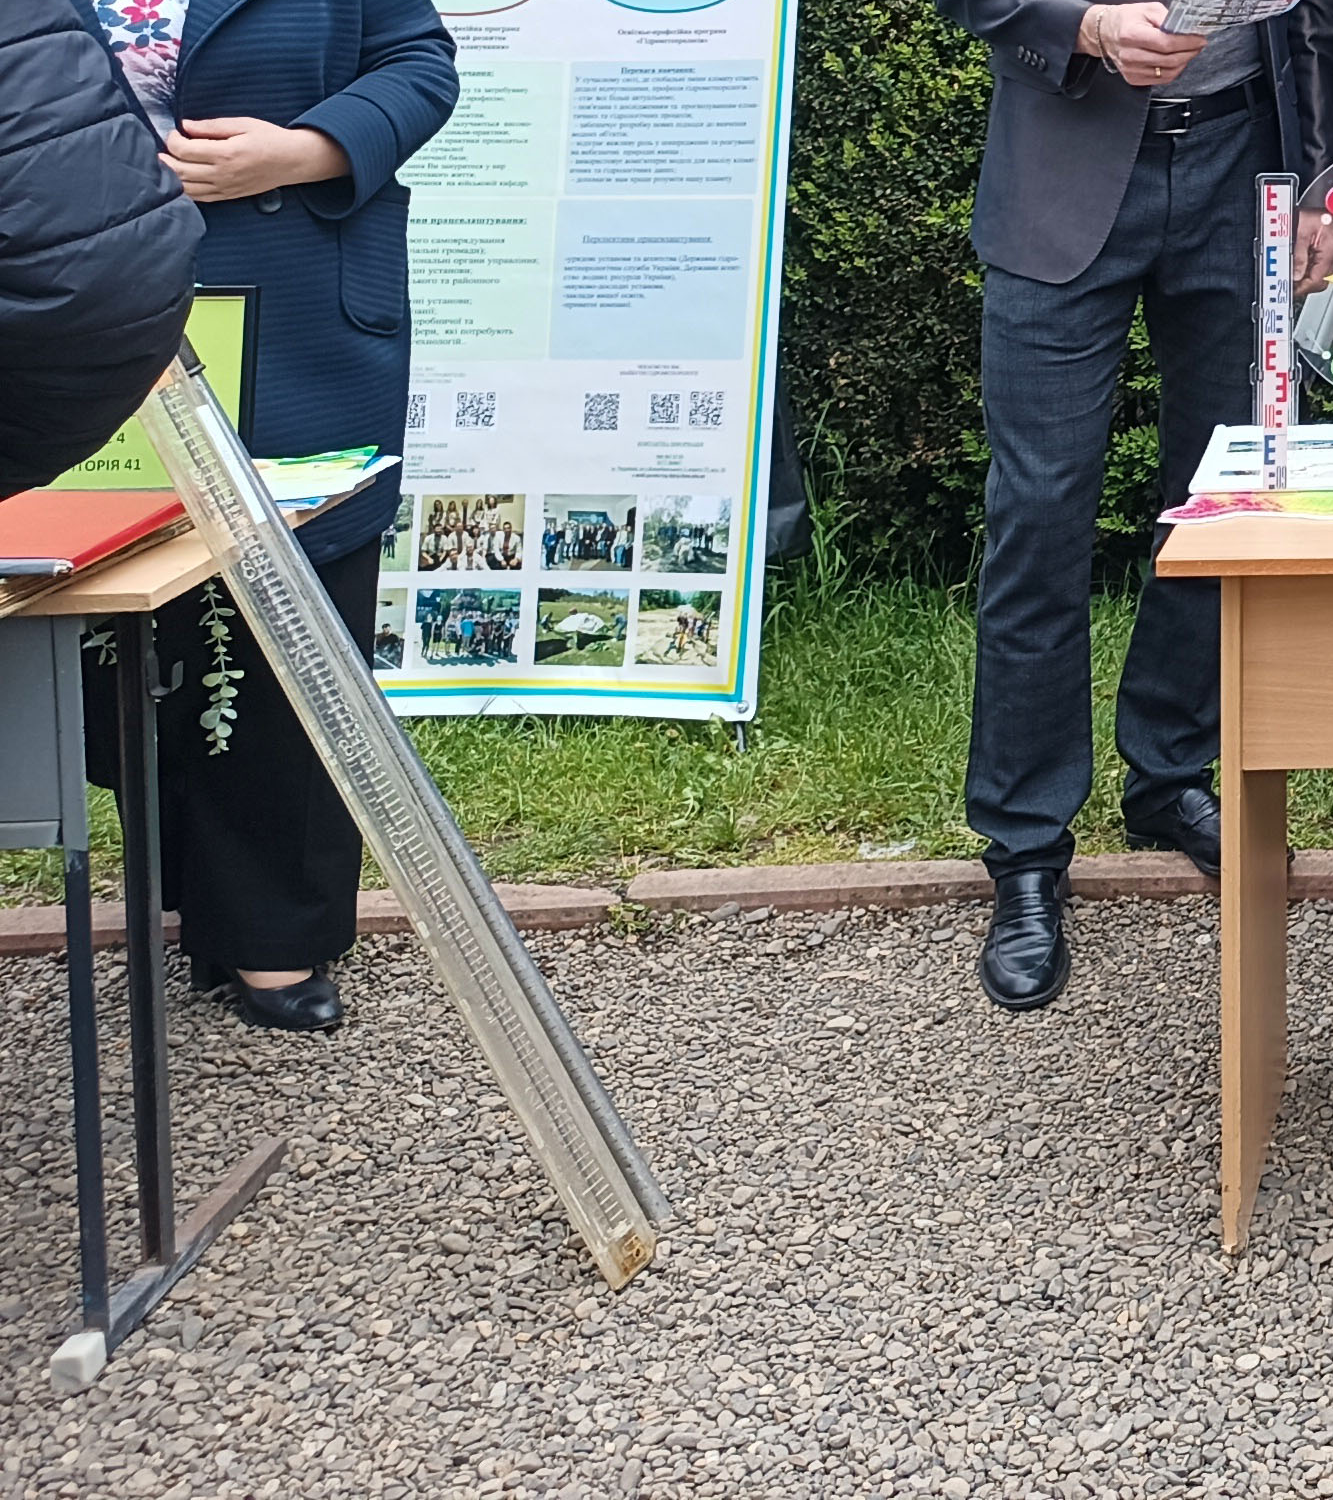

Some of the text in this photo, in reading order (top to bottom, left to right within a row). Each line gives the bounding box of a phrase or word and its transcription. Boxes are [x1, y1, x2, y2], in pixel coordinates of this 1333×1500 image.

[1278, 213, 1288, 237] 39
[1277, 279, 1288, 304] 29
[1265, 309, 1276, 334] 20
[1264, 404, 1275, 428] 10
[116, 432, 125, 444] 4
[124, 459, 141, 471] 41
